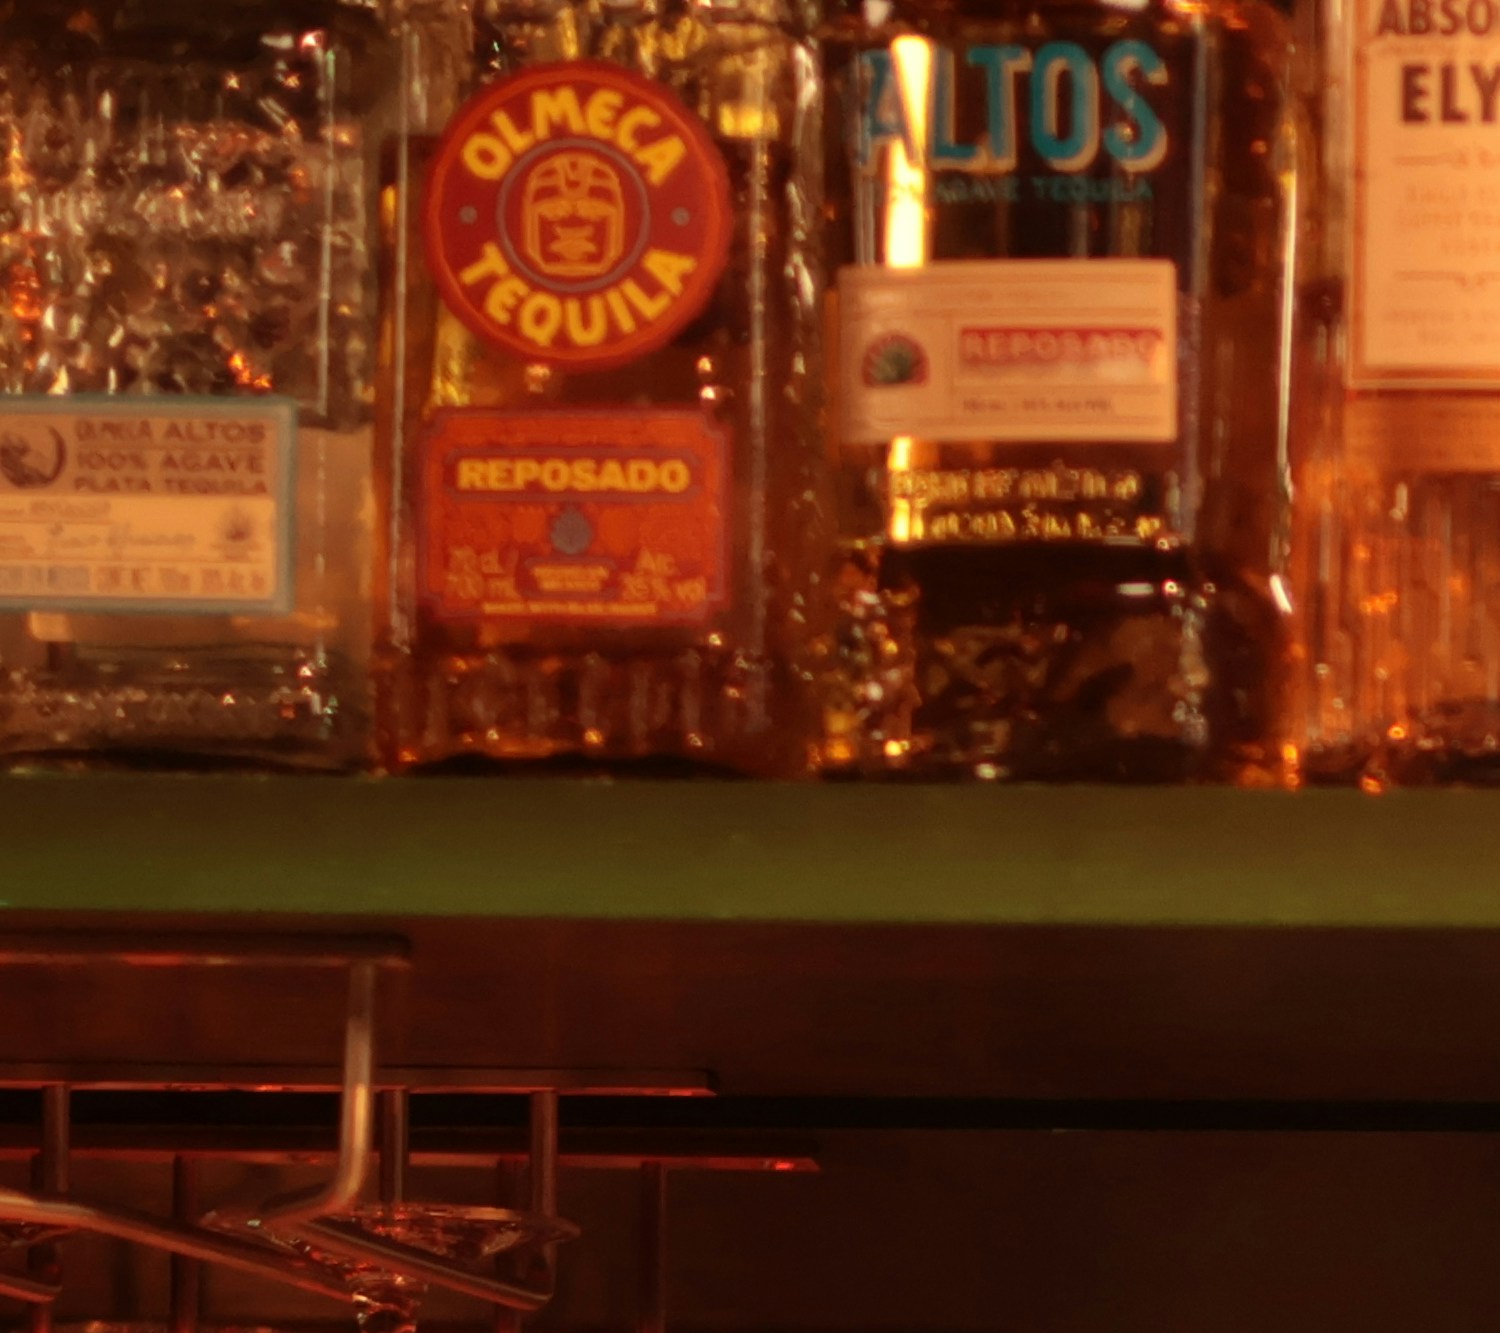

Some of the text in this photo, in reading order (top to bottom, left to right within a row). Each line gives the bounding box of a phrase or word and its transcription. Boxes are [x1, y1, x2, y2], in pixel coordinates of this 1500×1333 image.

[463, 86, 687, 187] OLMECA
[460, 242, 698, 347] TEQUILA
[162, 420, 266, 444] ALTOS
[456, 457, 692, 494] REPOSADO
